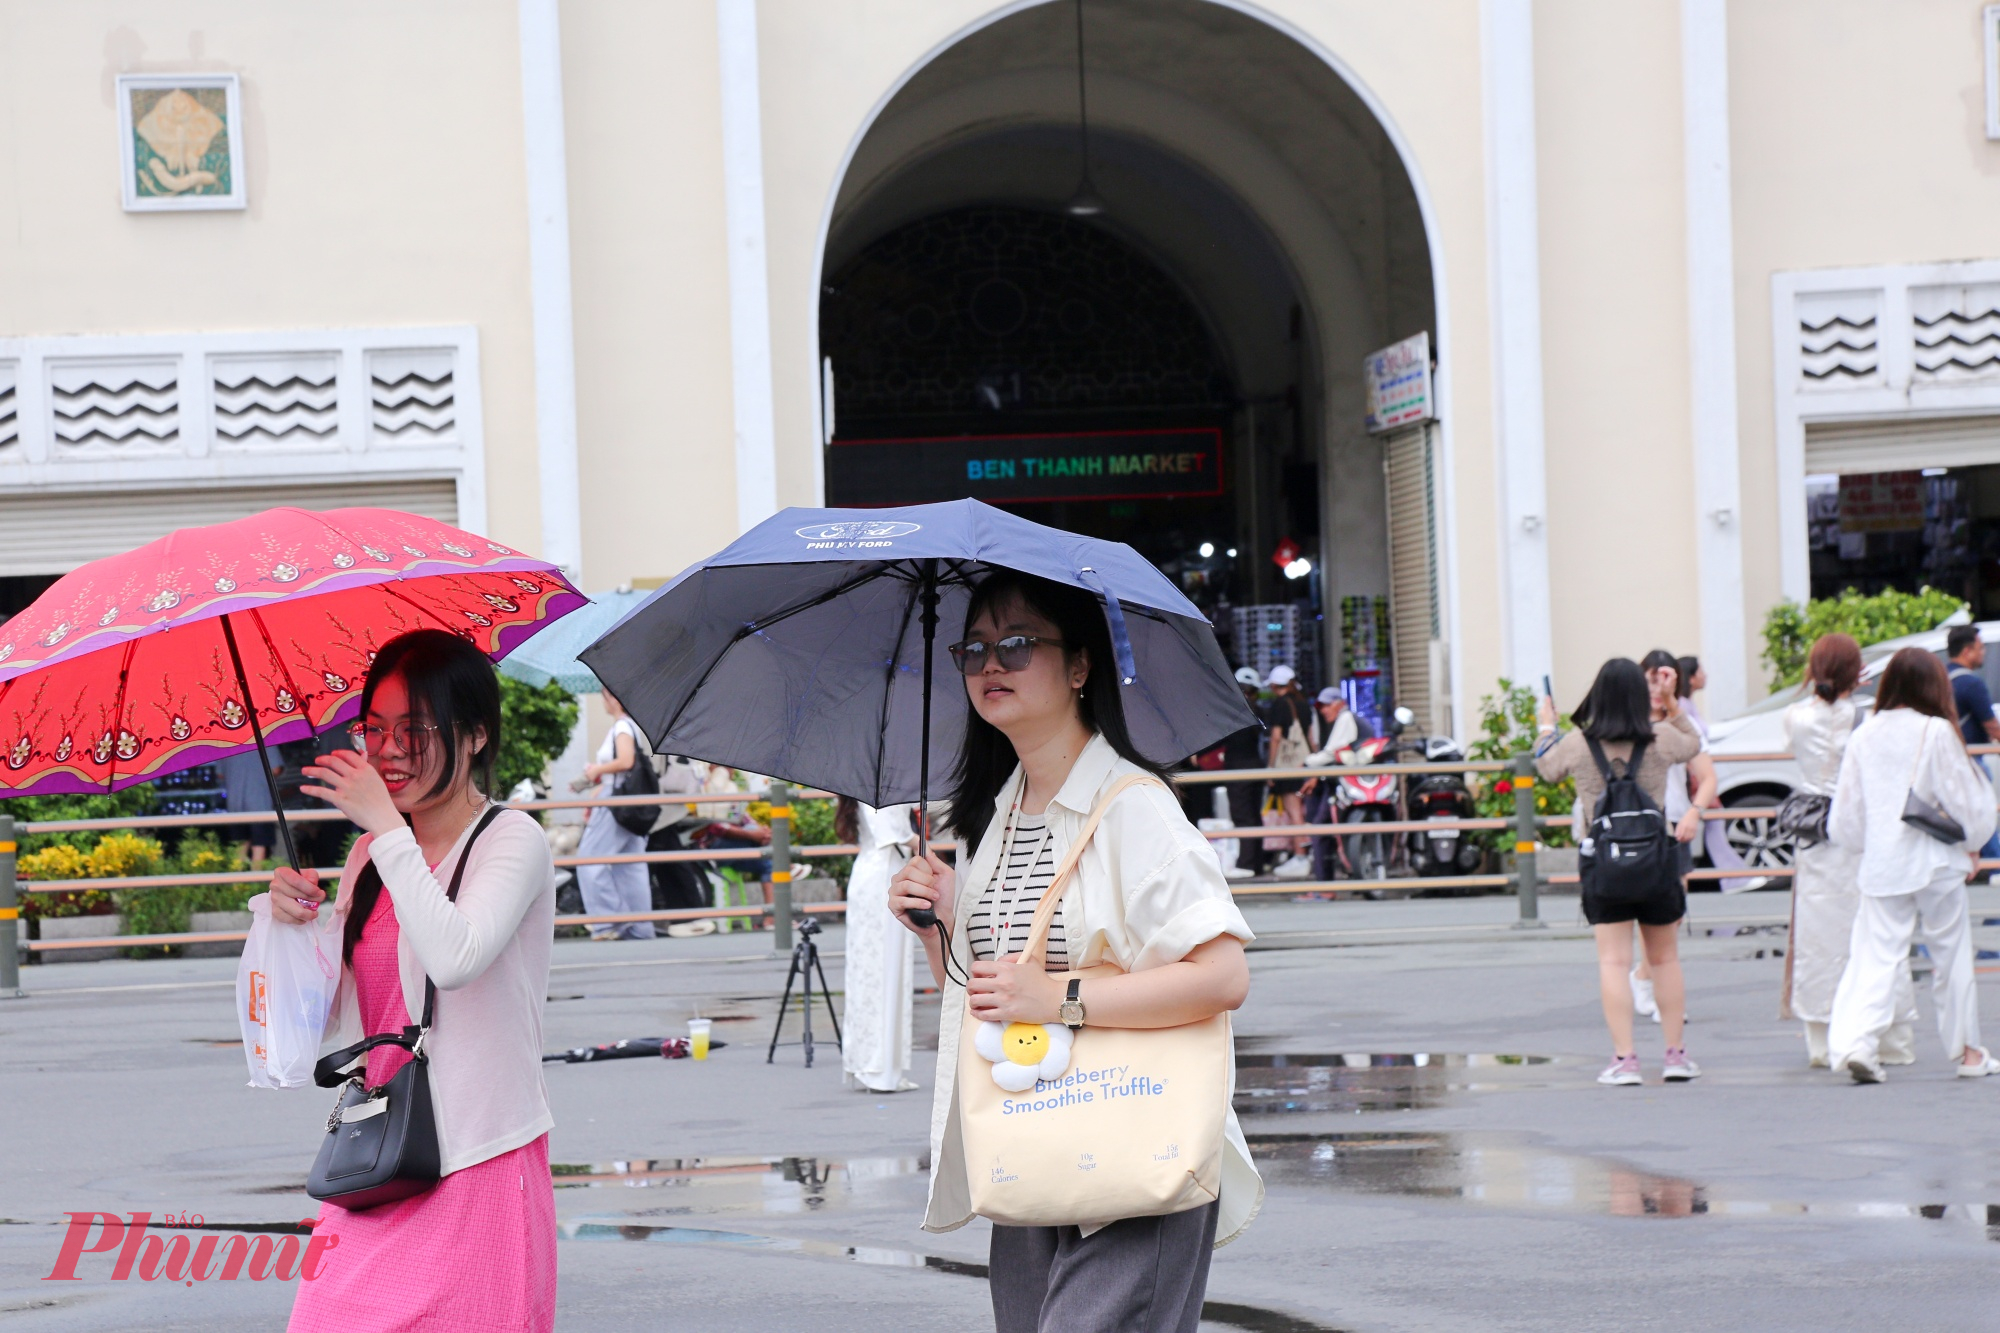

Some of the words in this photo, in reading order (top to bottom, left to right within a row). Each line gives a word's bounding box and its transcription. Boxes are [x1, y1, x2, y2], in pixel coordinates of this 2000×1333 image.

[967, 460, 1015, 480] BEN
[1021, 457, 1102, 479] THANH
[1109, 453, 1206, 475] MARKET
[820, 523, 896, 538] Fd
[806, 541, 834, 550] PHU
[857, 540, 893, 549] FORD
[1035, 1065, 1129, 1093] Blueberry
[1002, 1089, 1094, 1115] Smoothie
[991, 1173, 1019, 1184] Calories
